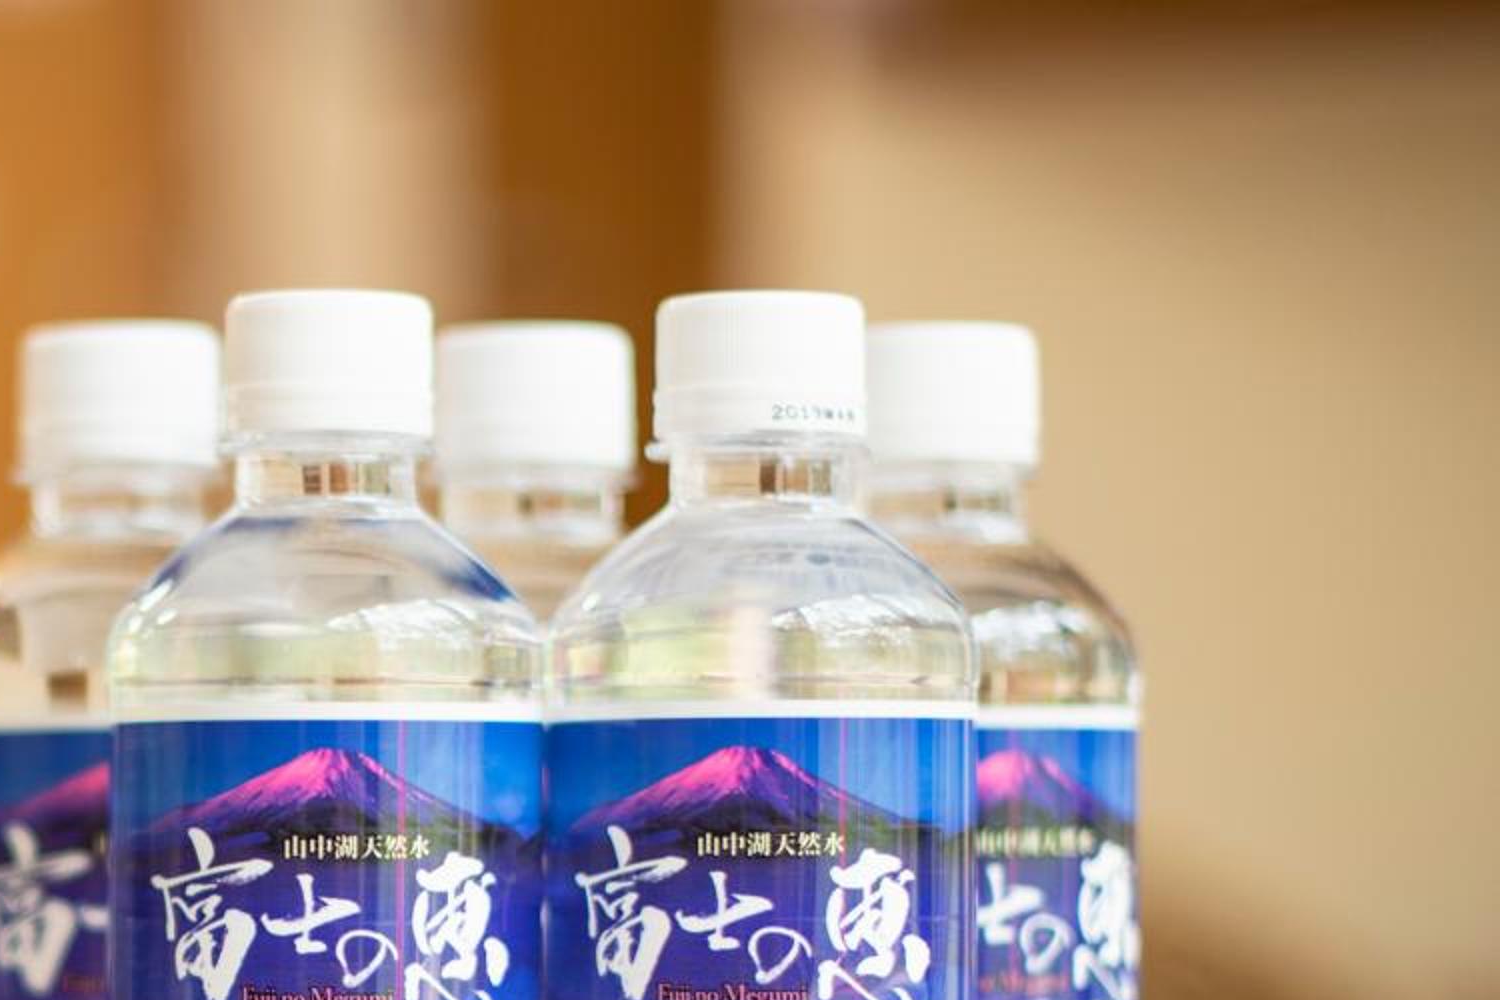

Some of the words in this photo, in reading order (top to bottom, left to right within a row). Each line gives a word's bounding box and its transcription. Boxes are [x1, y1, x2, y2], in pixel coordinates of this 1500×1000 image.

[283, 834, 431, 862] 山中湖天然水
[697, 831, 846, 858] 山中湖天然水
